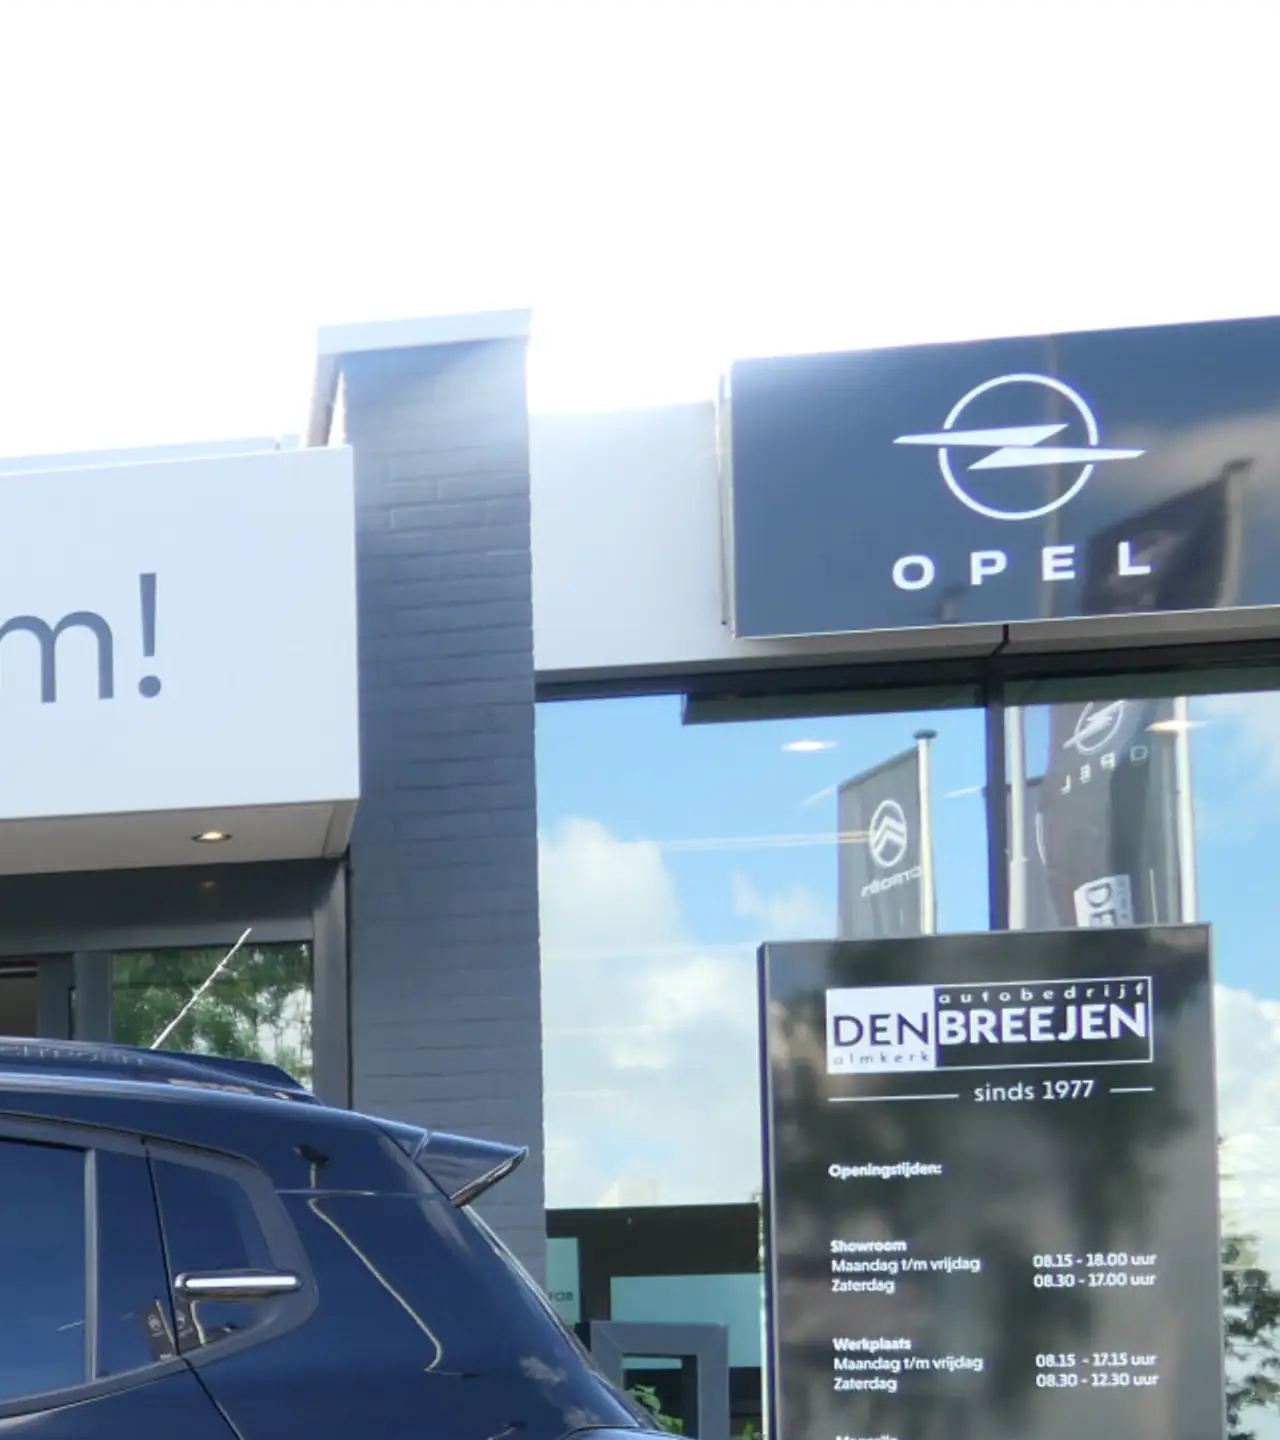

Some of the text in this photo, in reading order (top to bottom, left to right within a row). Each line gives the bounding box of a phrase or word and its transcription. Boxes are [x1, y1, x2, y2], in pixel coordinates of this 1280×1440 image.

[892, 541, 1151, 591] OPEL
[939, 982, 1144, 1005] autobedrijf
[833, 1003, 1146, 1047] DEN BREEJEN
[832, 1051, 930, 1067] almkerk
[974, 1079, 1094, 1102] sinds 1977
[828, 1162, 942, 1180] Openingstijden:
[830, 1239, 907, 1253] Showroom
[832, 1258, 899, 1275] Maandag
[900, 1257, 927, 1271] t/m
[930, 1256, 981, 1273] vrijdag
[1131, 1254, 1157, 1266] uur
[832, 1278, 895, 1294] Zaterdag
[1130, 1273, 1156, 1286] uur
[832, 1337, 912, 1353] Werkplaats
[834, 1357, 901, 1373] Maandag
[903, 1356, 929, 1370] t/m
[932, 1355, 984, 1372] vrijdag
[1131, 1354, 1157, 1366] uur
[834, 1376, 898, 1393] Zaterdag
[1133, 1374, 1160, 1386] uur
